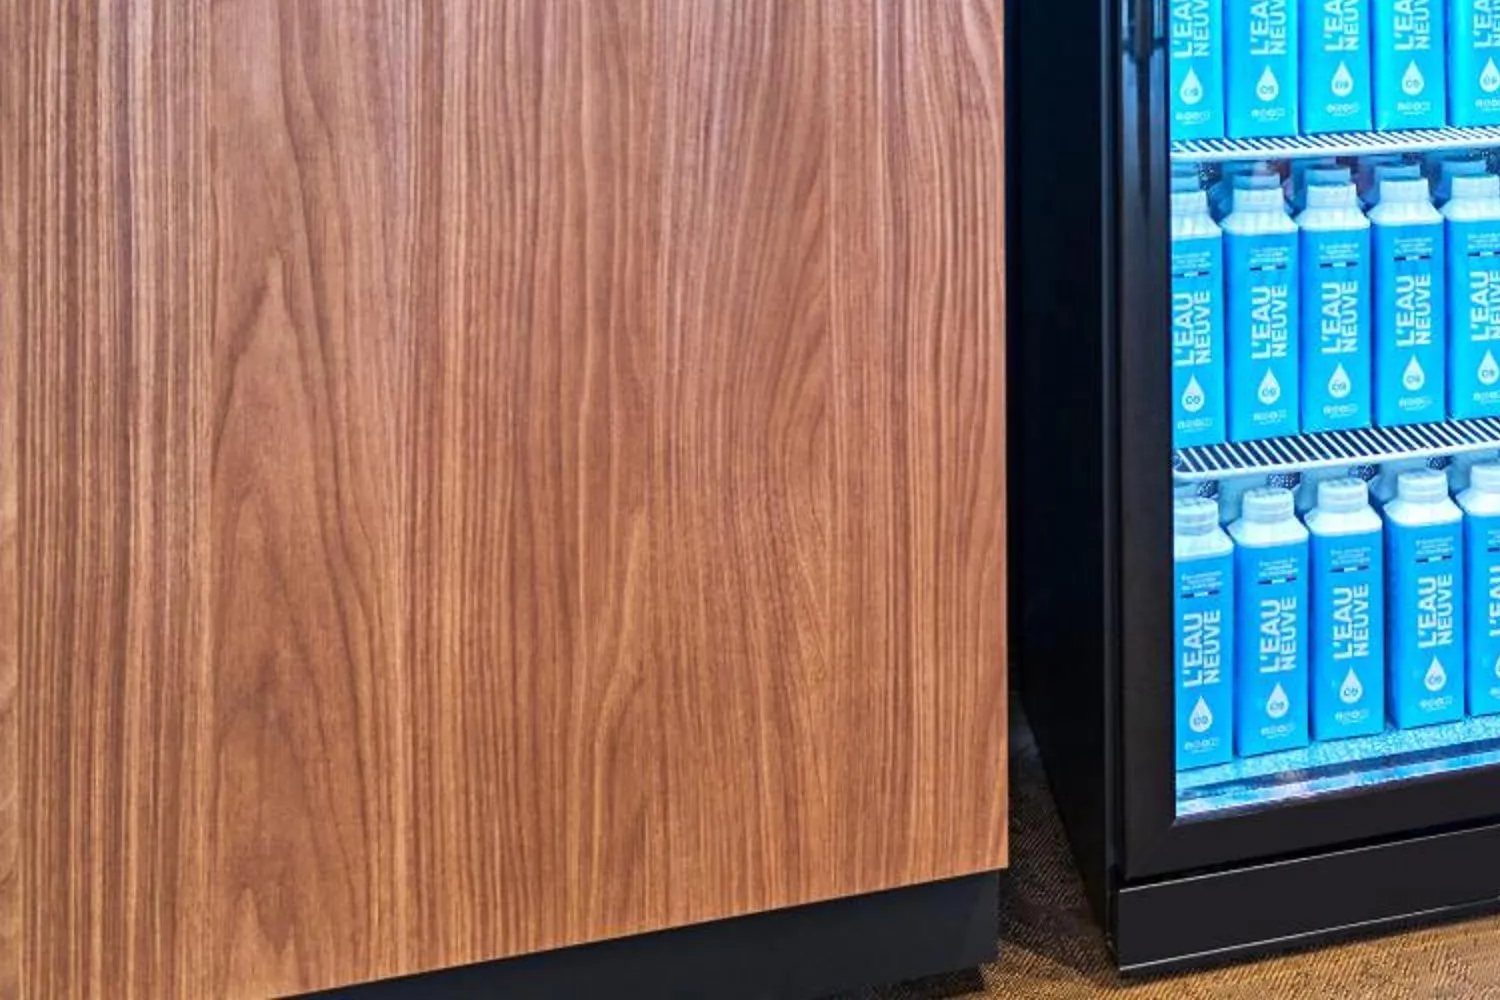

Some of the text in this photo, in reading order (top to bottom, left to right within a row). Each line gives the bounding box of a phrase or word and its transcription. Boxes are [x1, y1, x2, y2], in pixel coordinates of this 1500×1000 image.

[1172, 292, 1193, 367] L'EAU
[1193, 290, 1211, 365] NEUVE
[1251, 286, 1270, 359] L'EAU
[1270, 285, 1288, 358] NEUVE
[1321, 282, 1341, 354] L'EAU
[1341, 281, 1358, 353] NEUVE
[1396, 275, 1415, 347] L'EAU
[1414, 274, 1431, 345] NEUVE
[1470, 271, 1490, 341] L'EAU
[1260, 599, 1280, 673] L'EAU
[1279, 596, 1297, 671] NEUVE
[1333, 587, 1352, 660] L'EAU
[1352, 584, 1369, 657] NEUVE
[1417, 576, 1437, 648] L'EAU
[1436, 574, 1453, 645] NEUVE
[1183, 612, 1202, 687] L'EAU
[1202, 609, 1221, 685] NEUVE
